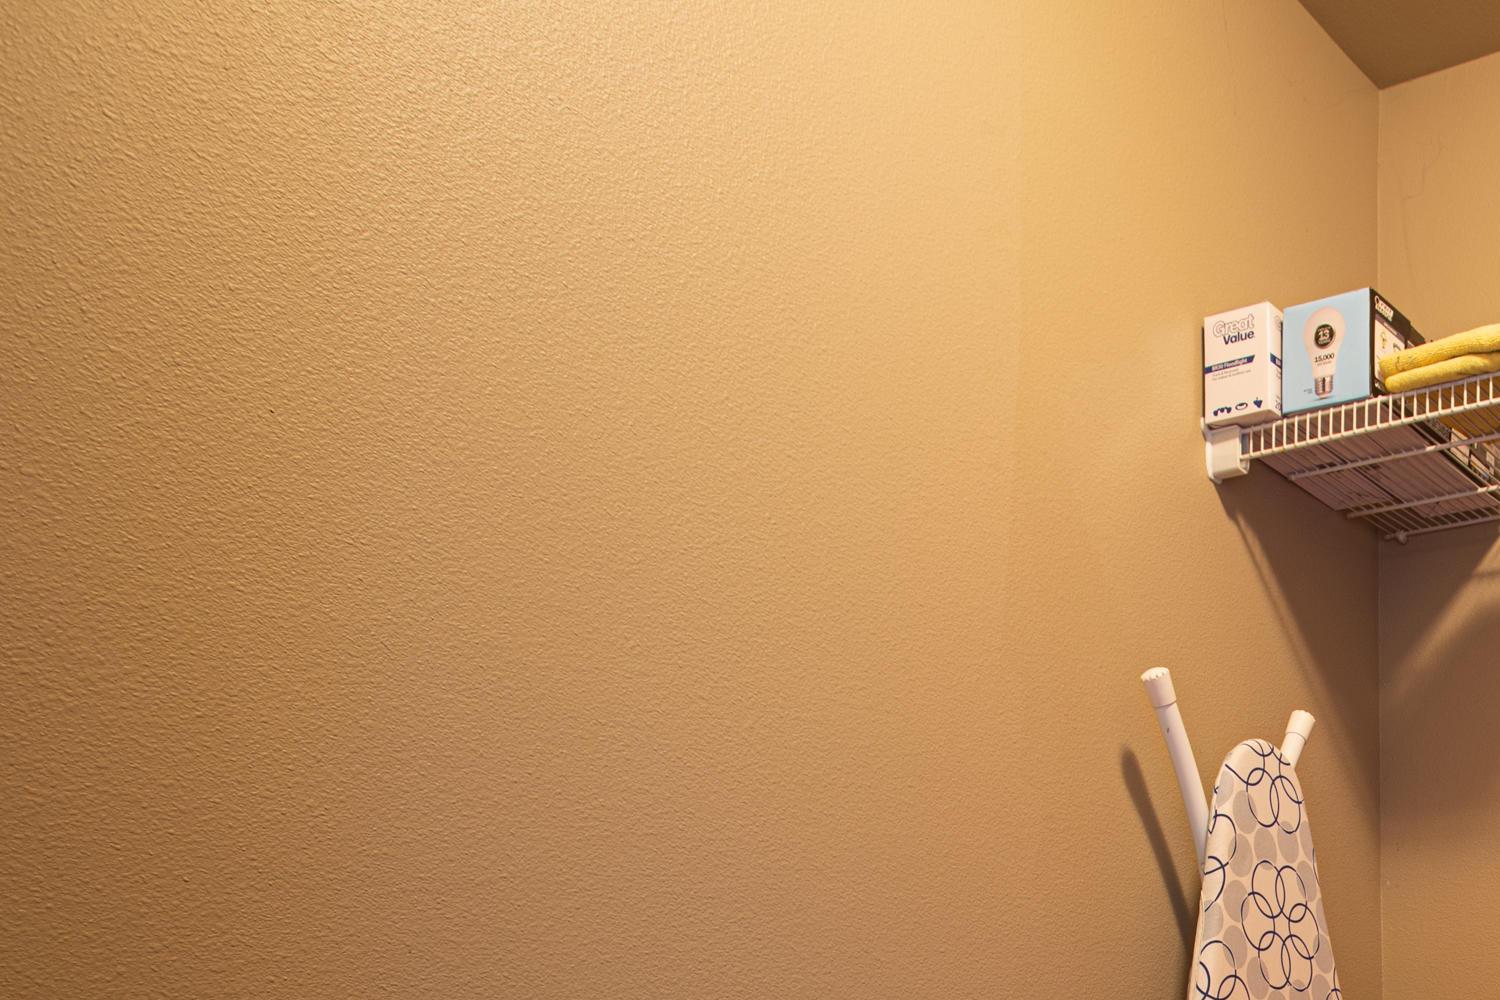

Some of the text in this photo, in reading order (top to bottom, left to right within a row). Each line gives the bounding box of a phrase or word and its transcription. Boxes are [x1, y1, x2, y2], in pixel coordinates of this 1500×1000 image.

[1213, 313, 1255, 338] Great
[1223, 330, 1254, 345] Value
[1318, 329, 1330, 338] 13
